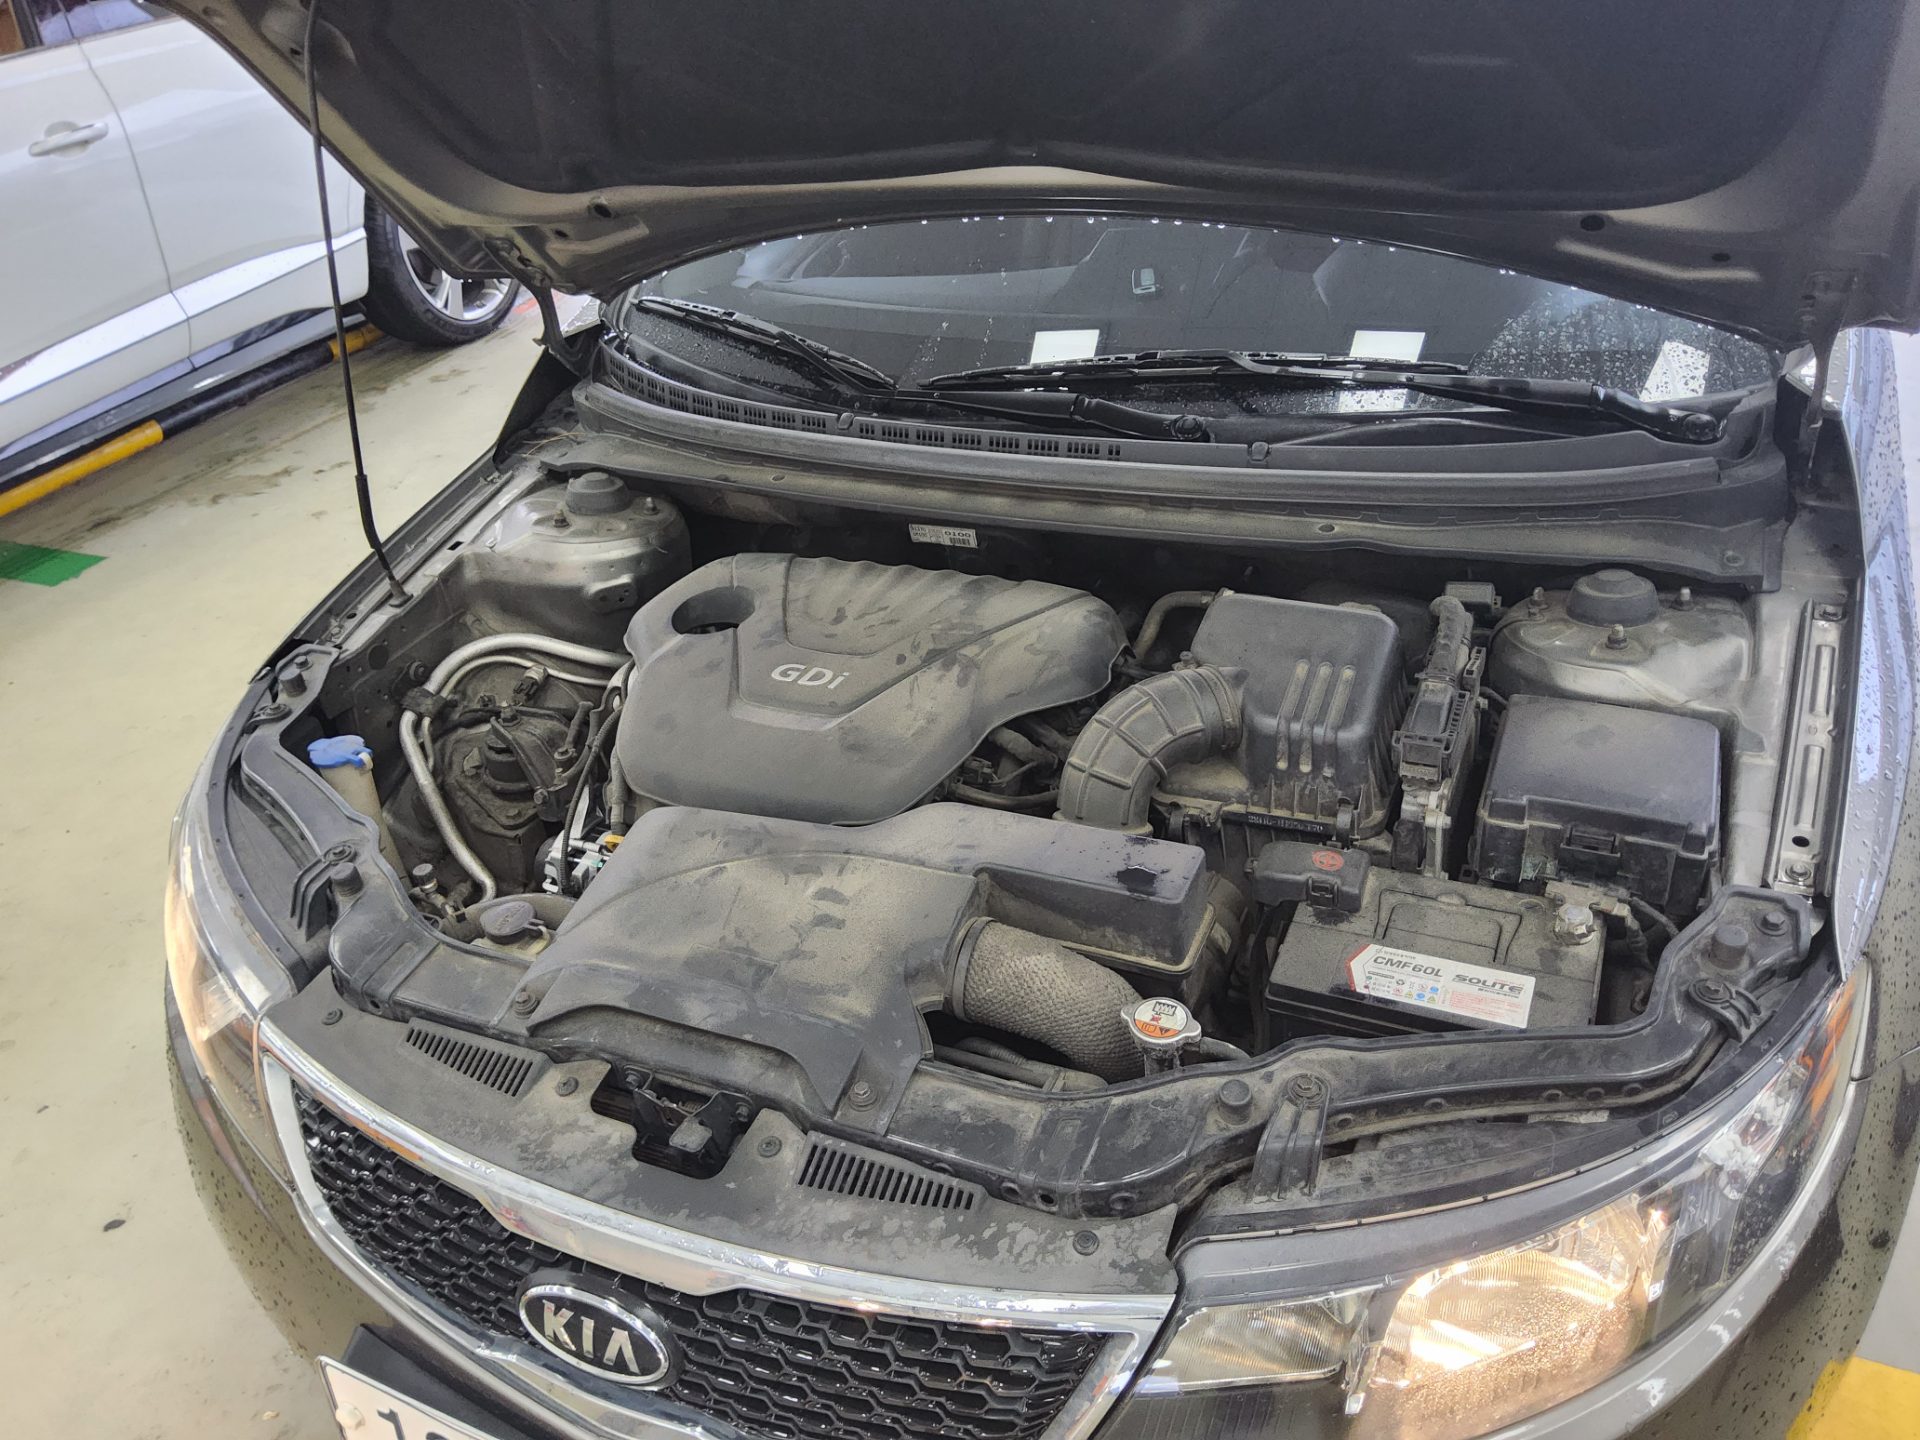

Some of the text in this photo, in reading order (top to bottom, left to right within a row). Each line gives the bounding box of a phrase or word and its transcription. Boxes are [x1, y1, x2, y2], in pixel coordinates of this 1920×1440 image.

[771, 663, 850, 689] GDi
[1373, 956, 1443, 977] CMF60L
[1452, 974, 1524, 994] SOLITE
[542, 1299, 641, 1375] KIA
